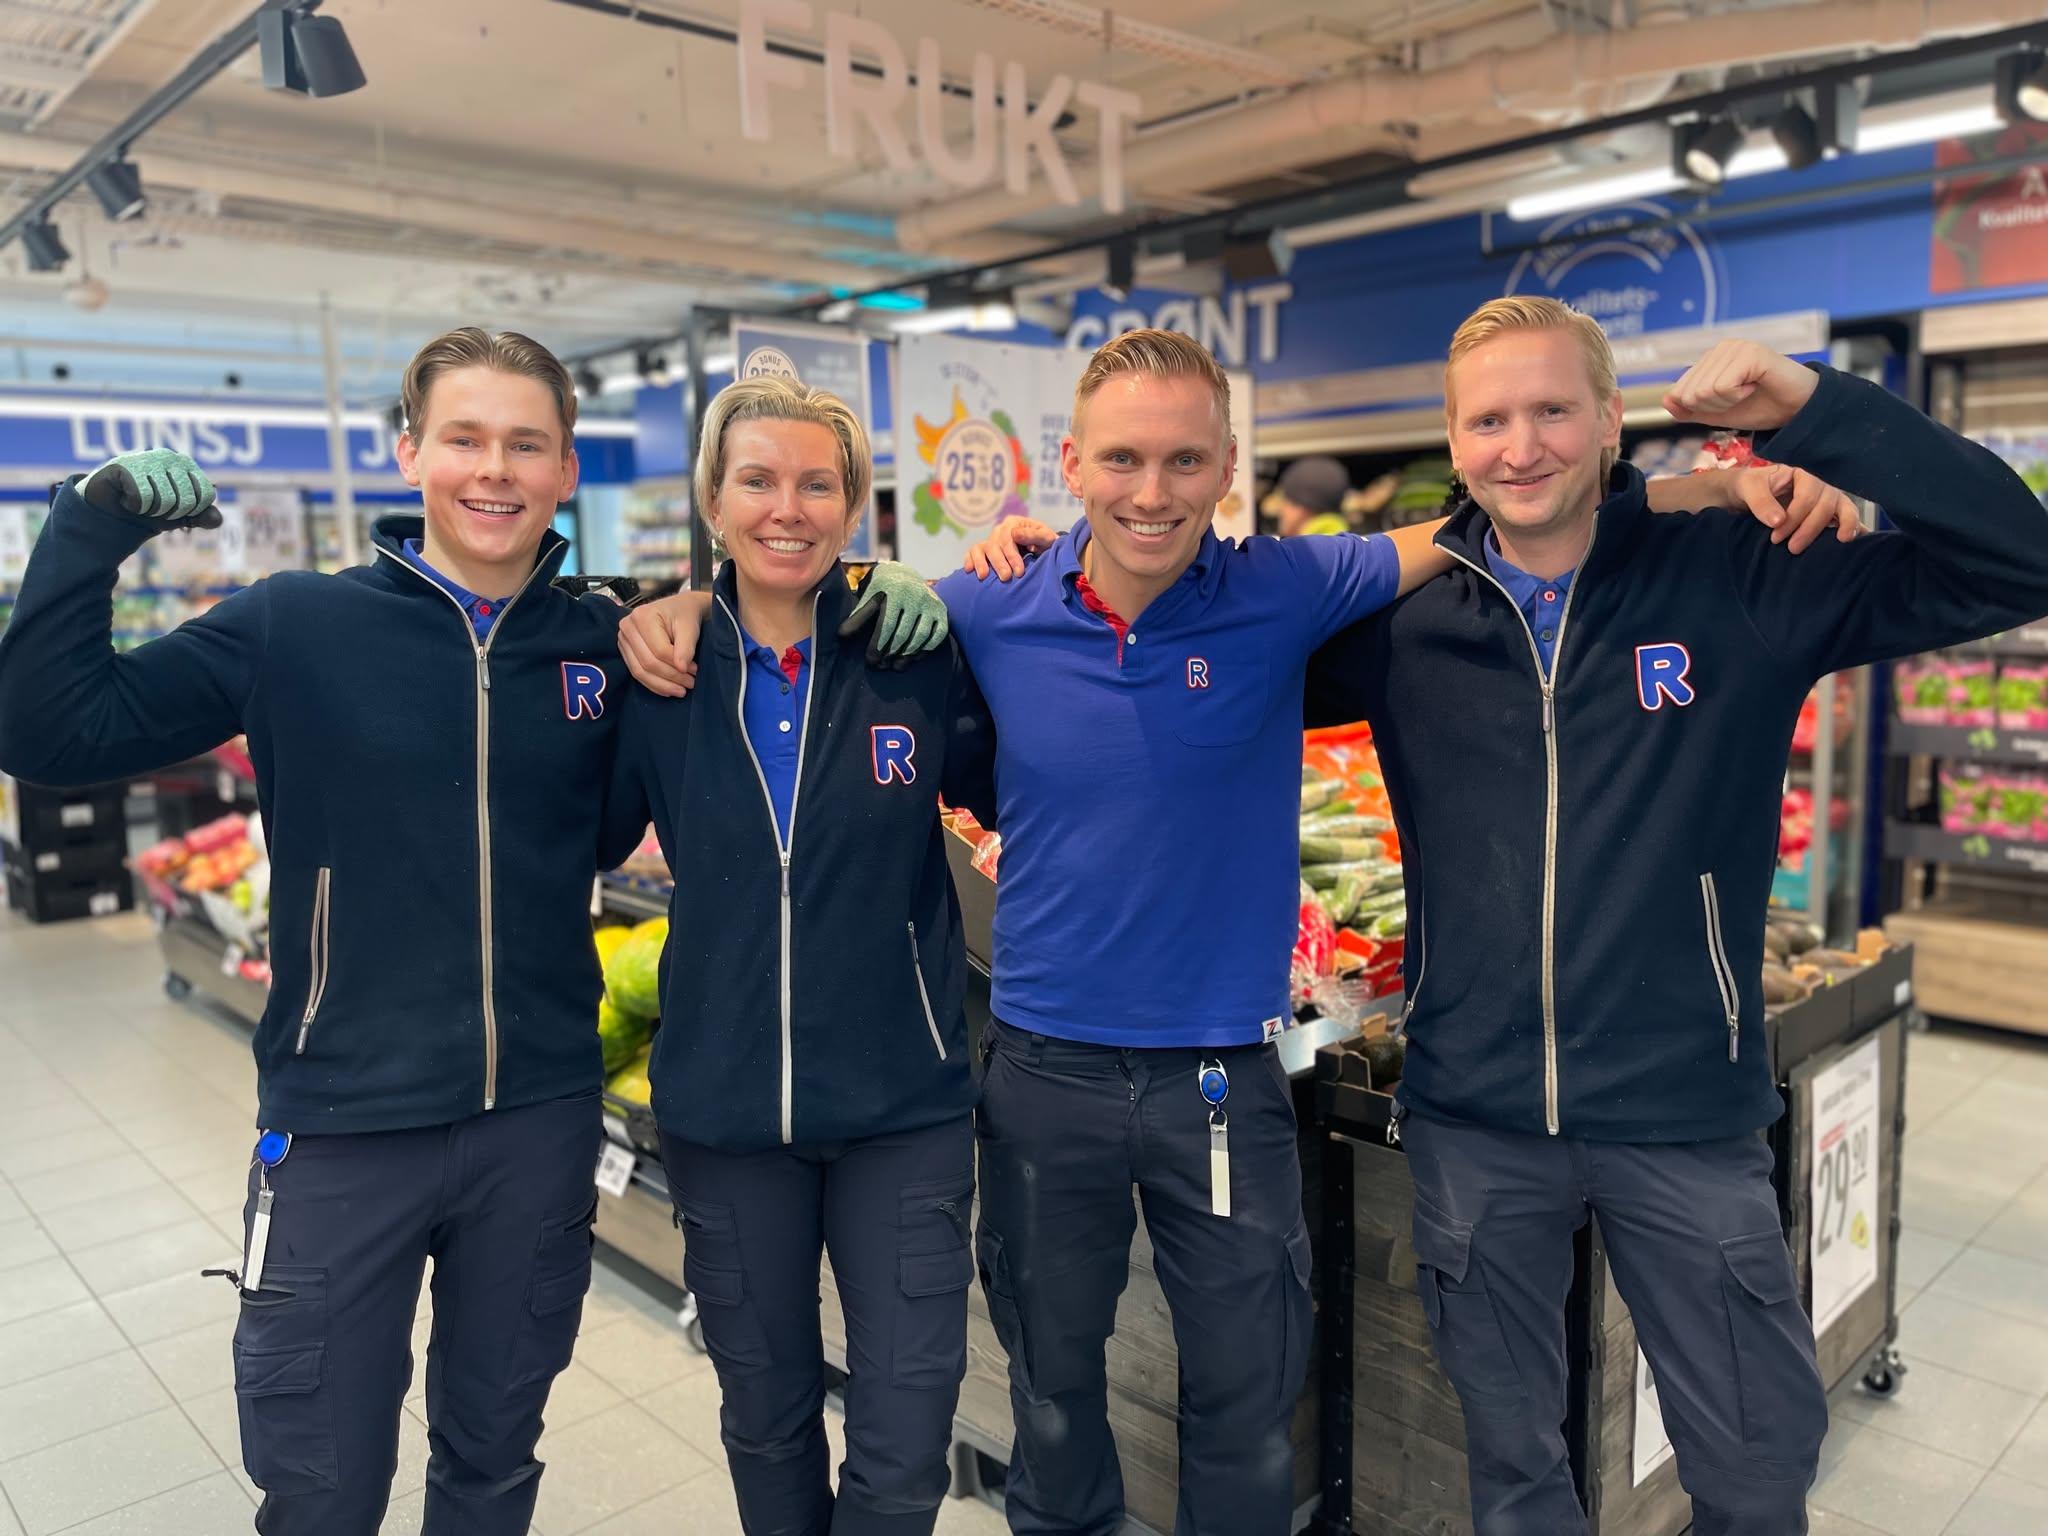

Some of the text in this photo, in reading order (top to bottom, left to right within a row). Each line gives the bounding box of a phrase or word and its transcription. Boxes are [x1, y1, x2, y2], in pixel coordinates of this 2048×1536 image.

[738, 0, 1141, 214] FRUKT
[758, 352, 781, 366] BONUS
[69, 413, 264, 468] LUNSJ
[991, 453, 1005, 491] 8
[560, 660, 607, 721] R
[1186, 656, 1210, 689] R
[1634, 642, 1695, 711] R
[870, 723, 917, 786] R
[1816, 1138, 1849, 1257] 29
